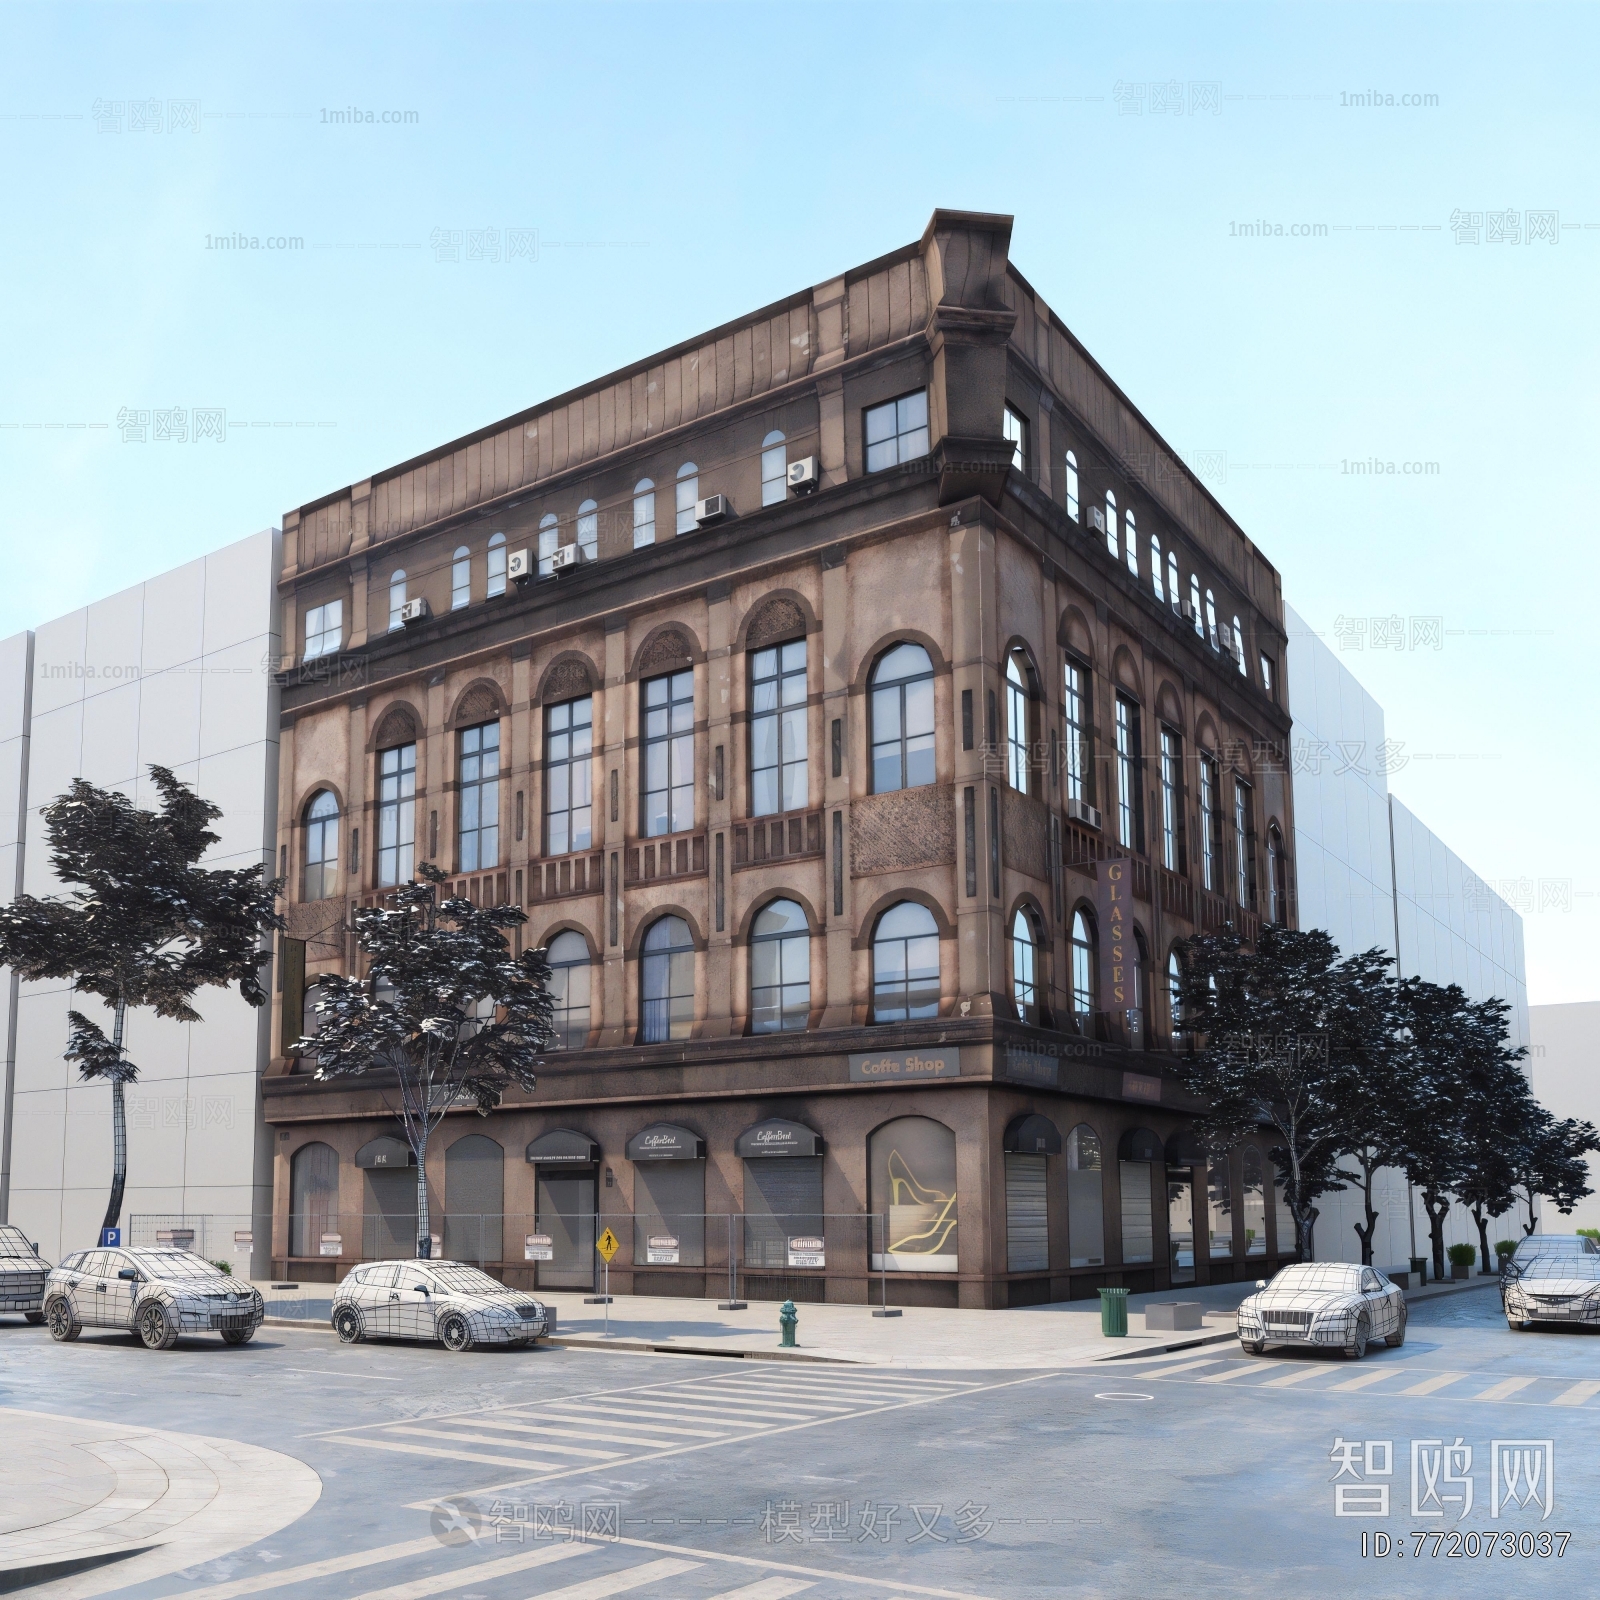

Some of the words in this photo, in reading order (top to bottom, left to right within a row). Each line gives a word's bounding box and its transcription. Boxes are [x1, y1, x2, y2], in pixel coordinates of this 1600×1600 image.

[1108, 864, 1125, 1003] GLASSES
[905, 1056, 945, 1075] Shop
[107, 1231, 116, 1245] P
